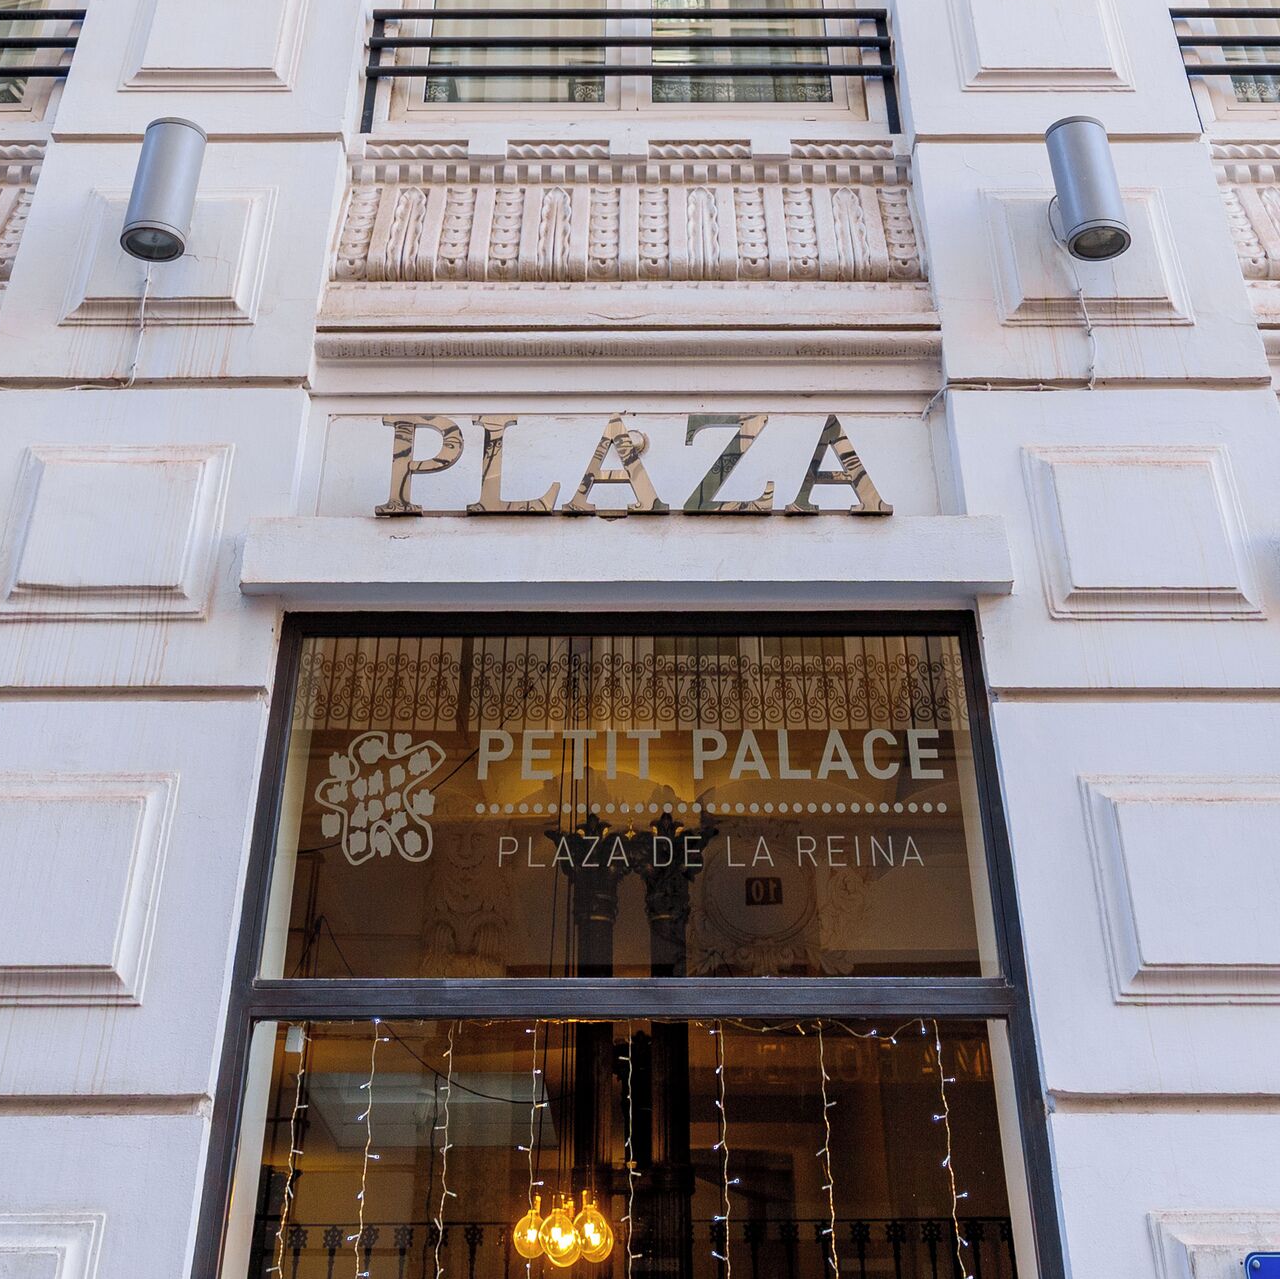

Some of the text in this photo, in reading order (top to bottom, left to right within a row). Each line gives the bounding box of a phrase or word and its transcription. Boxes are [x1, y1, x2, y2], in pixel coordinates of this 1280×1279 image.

[374, 413, 894, 516] PLAZA
[476, 728, 945, 781] PETIT PALACE
[497, 836, 925, 868] PLAZA DE LA REINA
